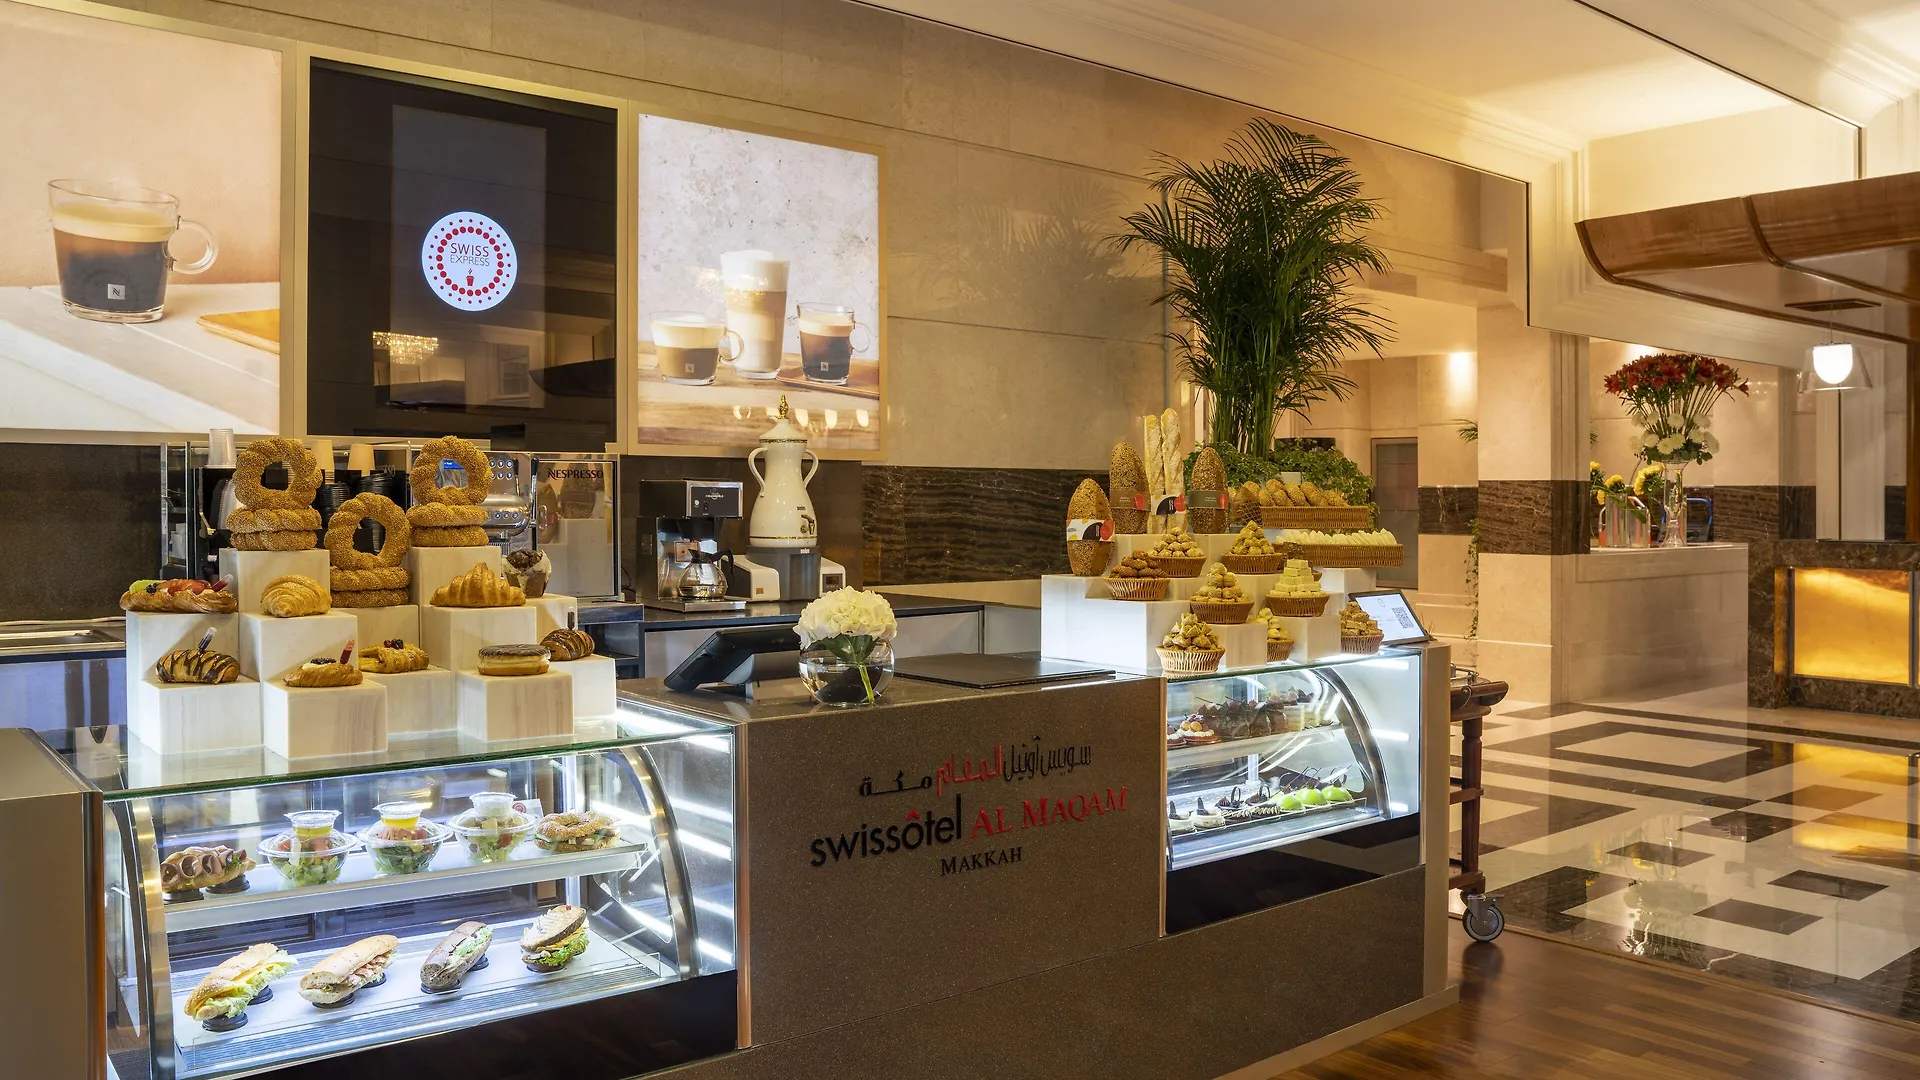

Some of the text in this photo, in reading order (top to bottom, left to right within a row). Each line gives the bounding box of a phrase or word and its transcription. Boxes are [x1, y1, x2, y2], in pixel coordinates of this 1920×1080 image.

[450, 242, 490, 258] SWISS
[450, 254, 490, 267] EXPRESS
[547, 468, 604, 480] NESPRESSO
[810, 787, 1127, 868] swissôtel AL MAQAM
[940, 846, 1024, 877] MAKKAH
